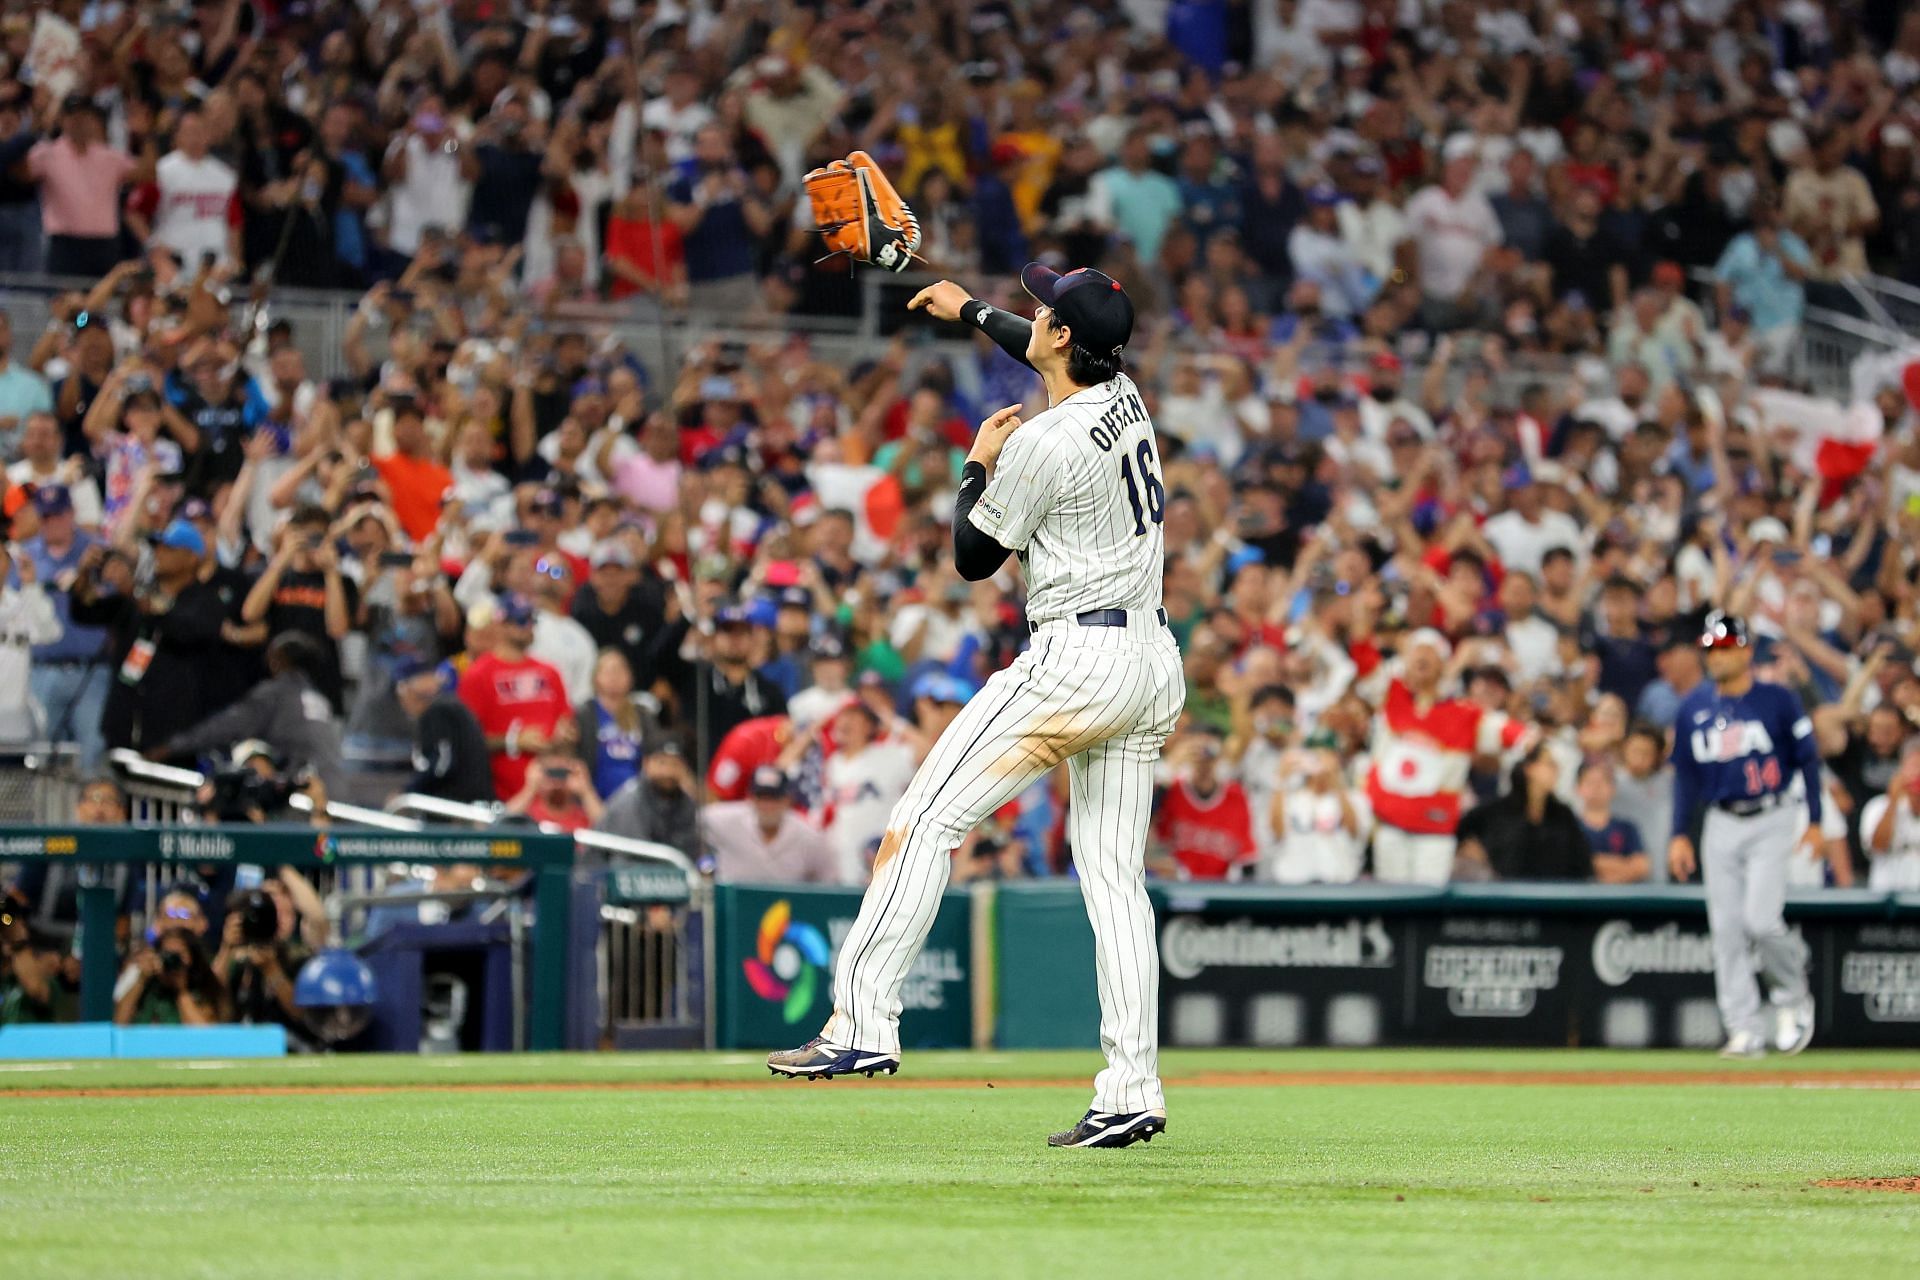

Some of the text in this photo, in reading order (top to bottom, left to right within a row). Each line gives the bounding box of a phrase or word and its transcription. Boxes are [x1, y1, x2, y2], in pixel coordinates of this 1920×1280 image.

[1090, 394, 1148, 452] OHTAN
[983, 502, 1002, 519] MUFG
[1121, 438, 1164, 536] 16
[1691, 720, 1773, 763] USA
[1744, 756, 1781, 795] 14
[1161, 916, 1361, 979] Continental
